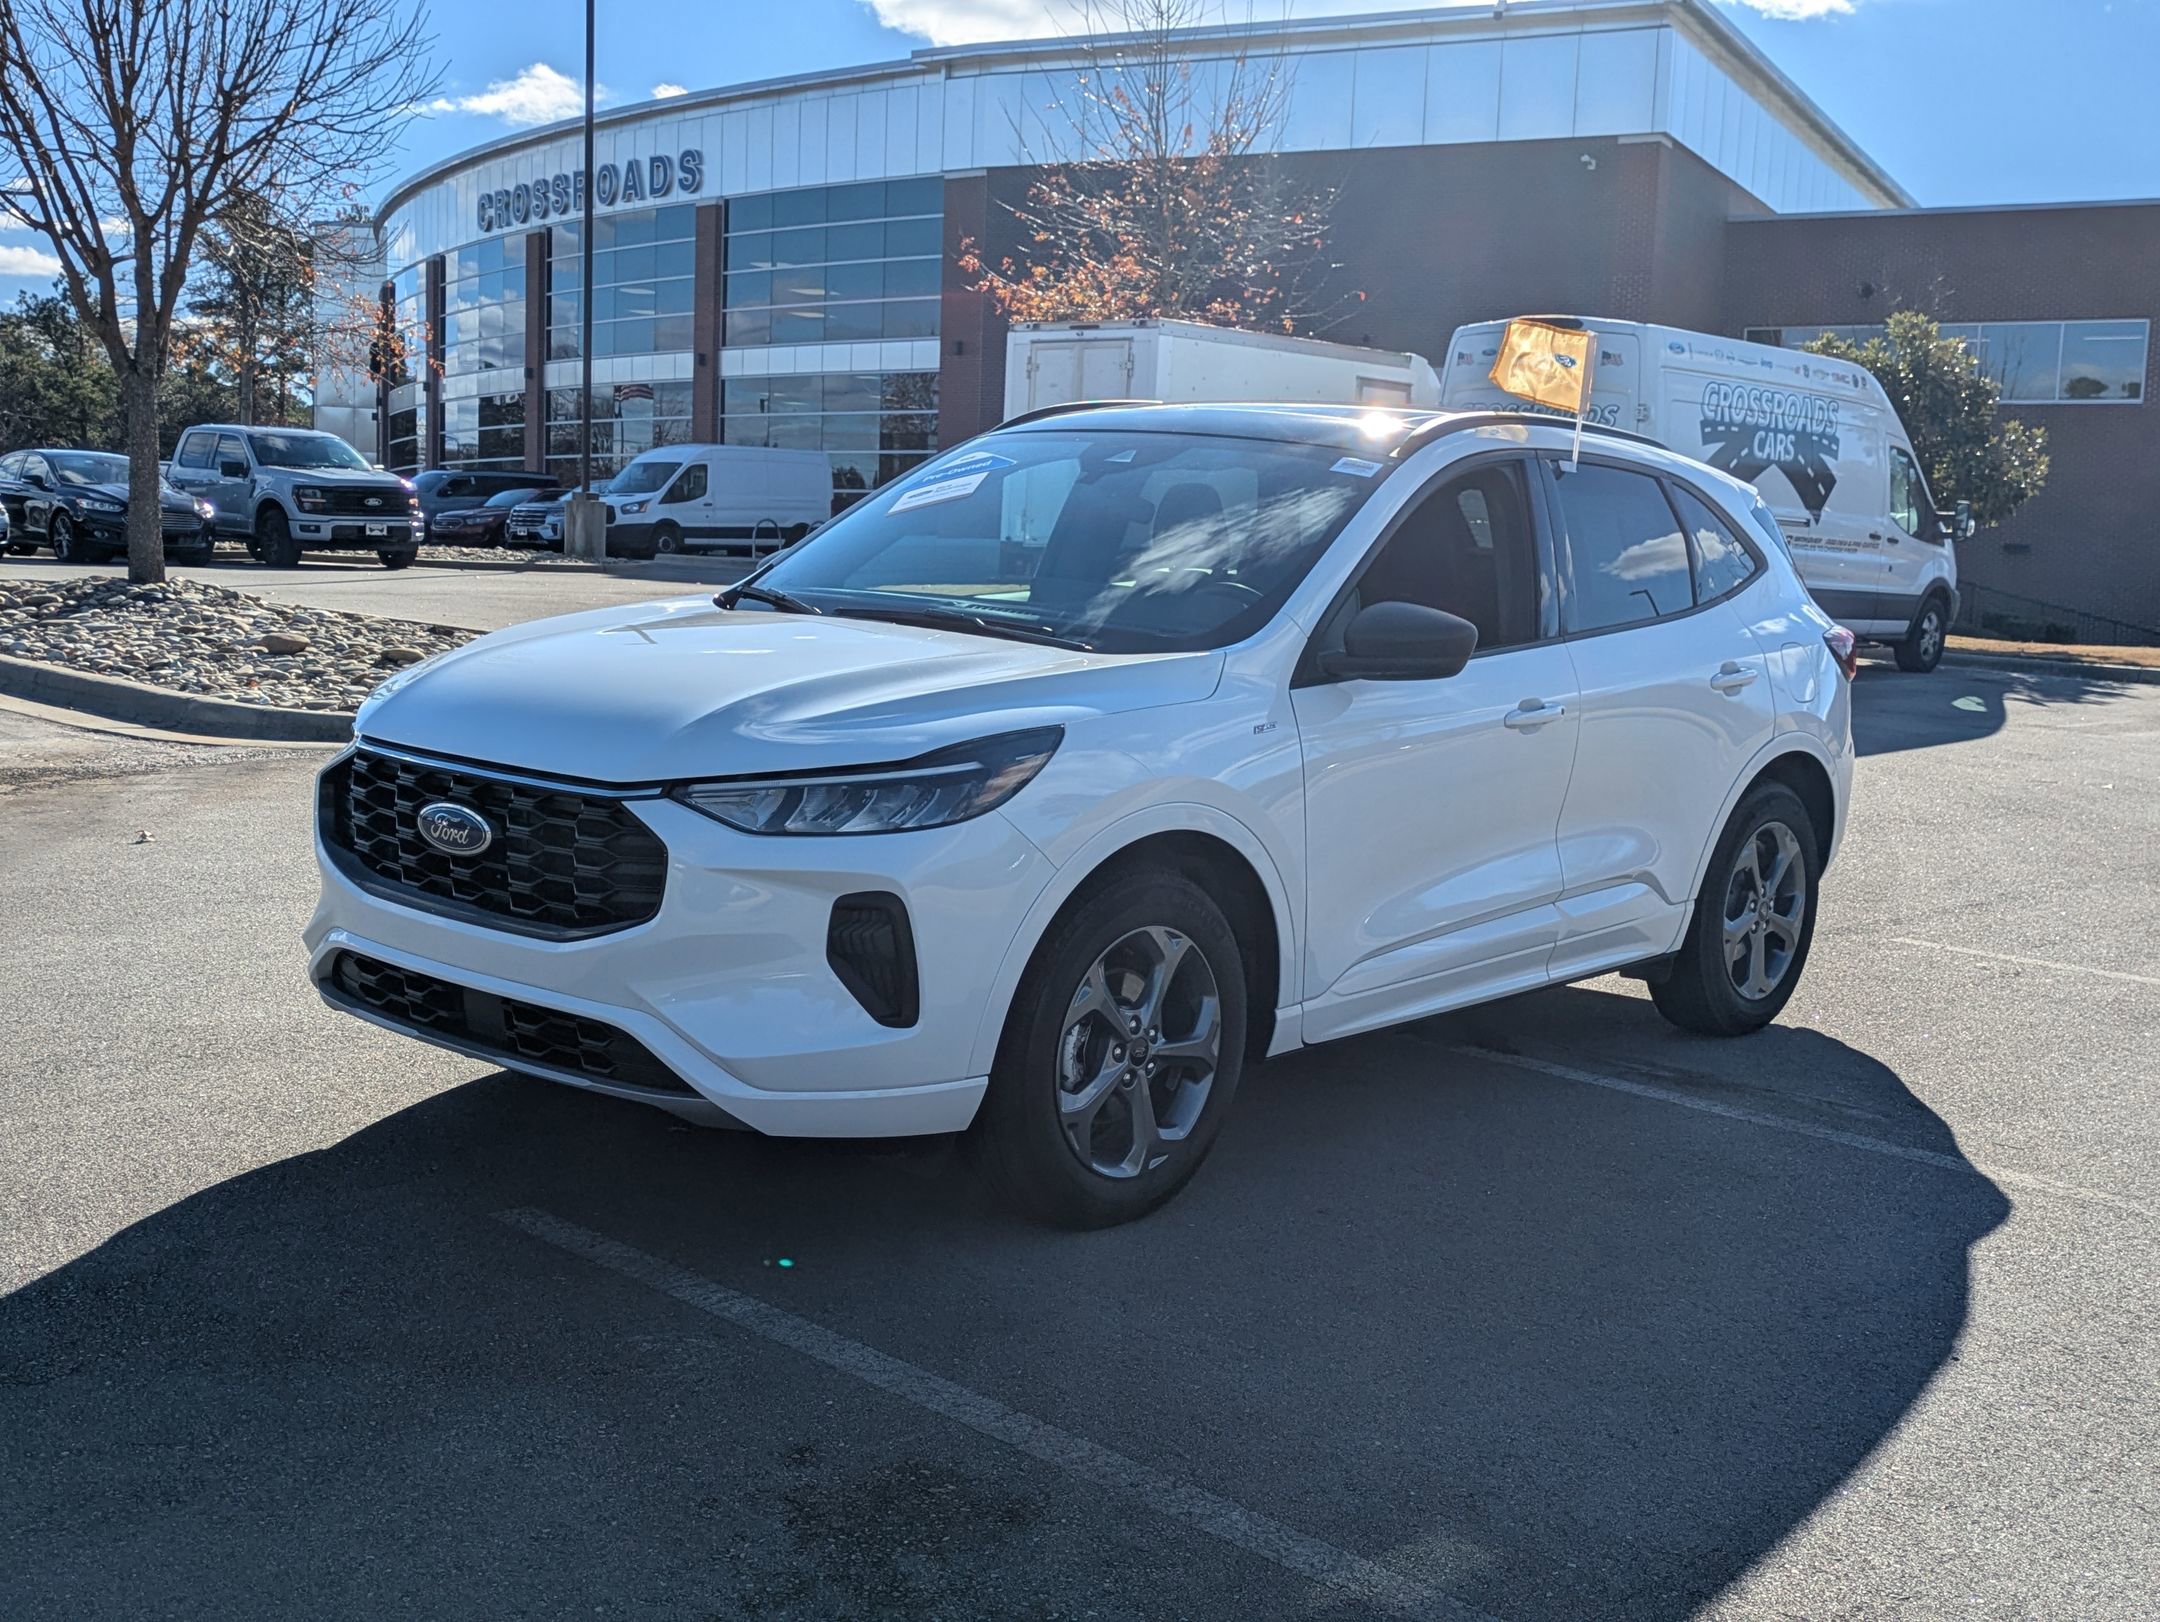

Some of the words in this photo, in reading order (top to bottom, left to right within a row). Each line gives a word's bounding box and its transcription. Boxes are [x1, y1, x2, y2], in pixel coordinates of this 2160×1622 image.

[477, 149, 703, 232] CROSSROADS
[1702, 382, 1839, 435] CROSSROADS
[1753, 430, 1796, 462] CARS
[430, 812, 471, 845] Ford
